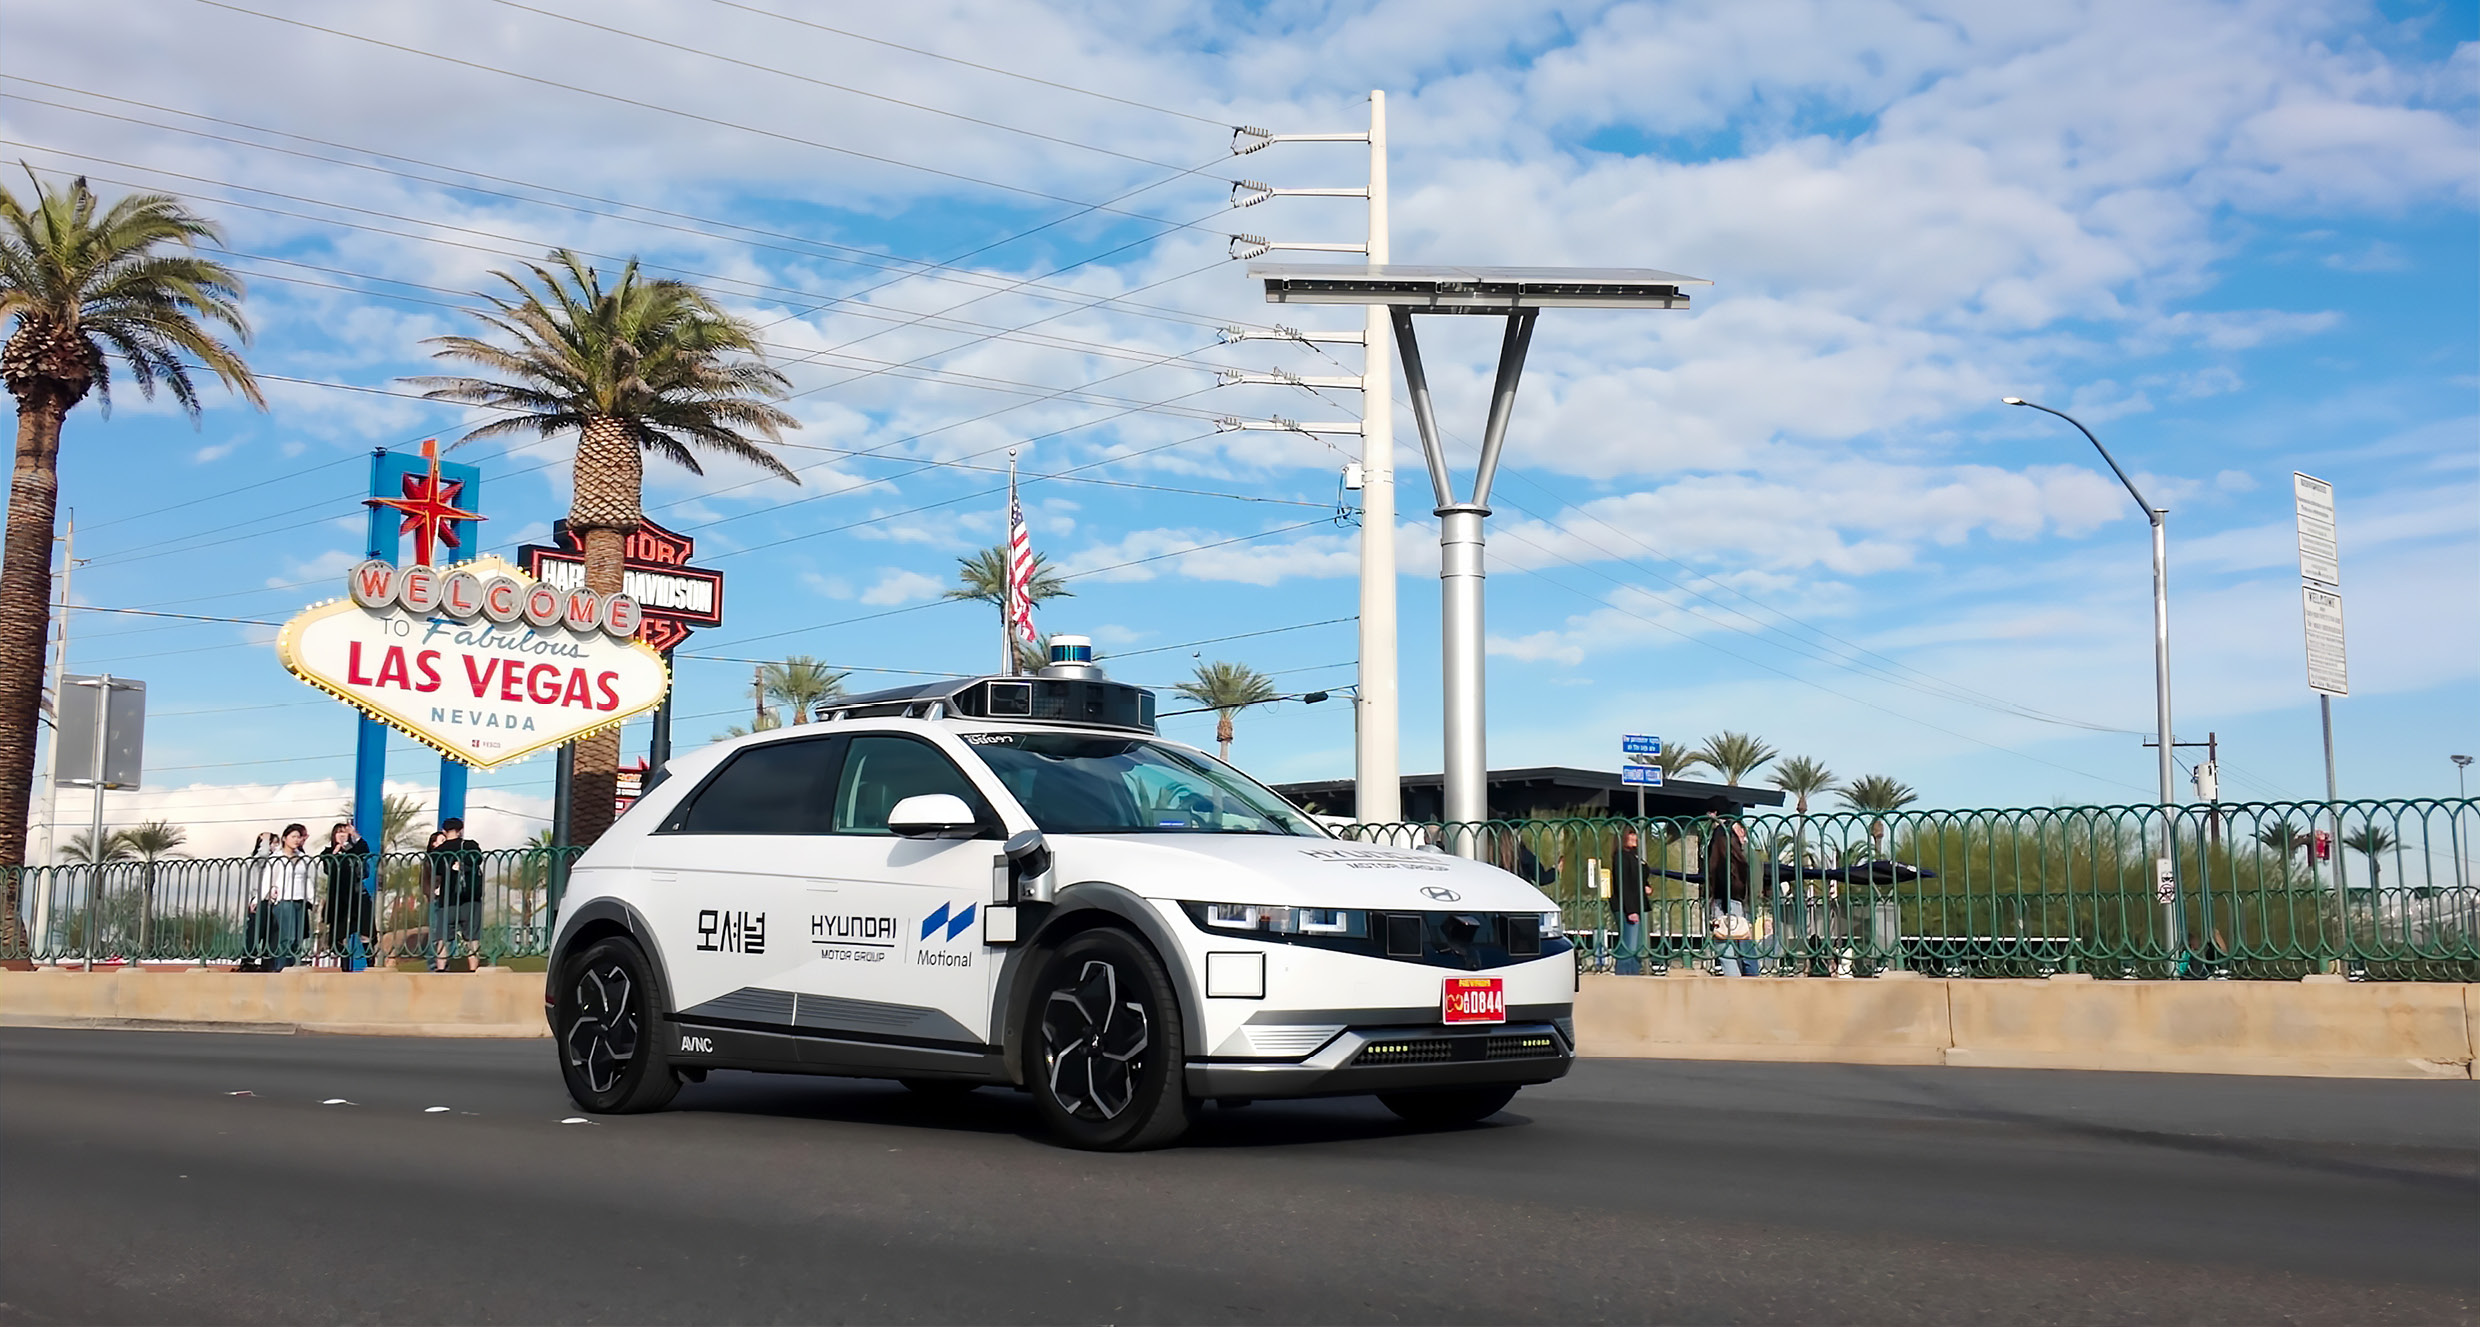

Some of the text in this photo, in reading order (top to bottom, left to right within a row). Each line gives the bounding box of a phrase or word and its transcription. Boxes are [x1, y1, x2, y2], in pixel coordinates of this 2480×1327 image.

[361, 569, 630, 629] WELCOME
[380, 616, 590, 659] TO Fabulous
[347, 641, 620, 712] LAS VEGAS
[431, 706, 536, 732] NEVADA
[812, 915, 896, 939] HYUNDAI
[821, 949, 885, 962] MOTOR GROUP
[917, 950, 972, 967] Motional
[681, 1036, 713, 1053] AVNC
